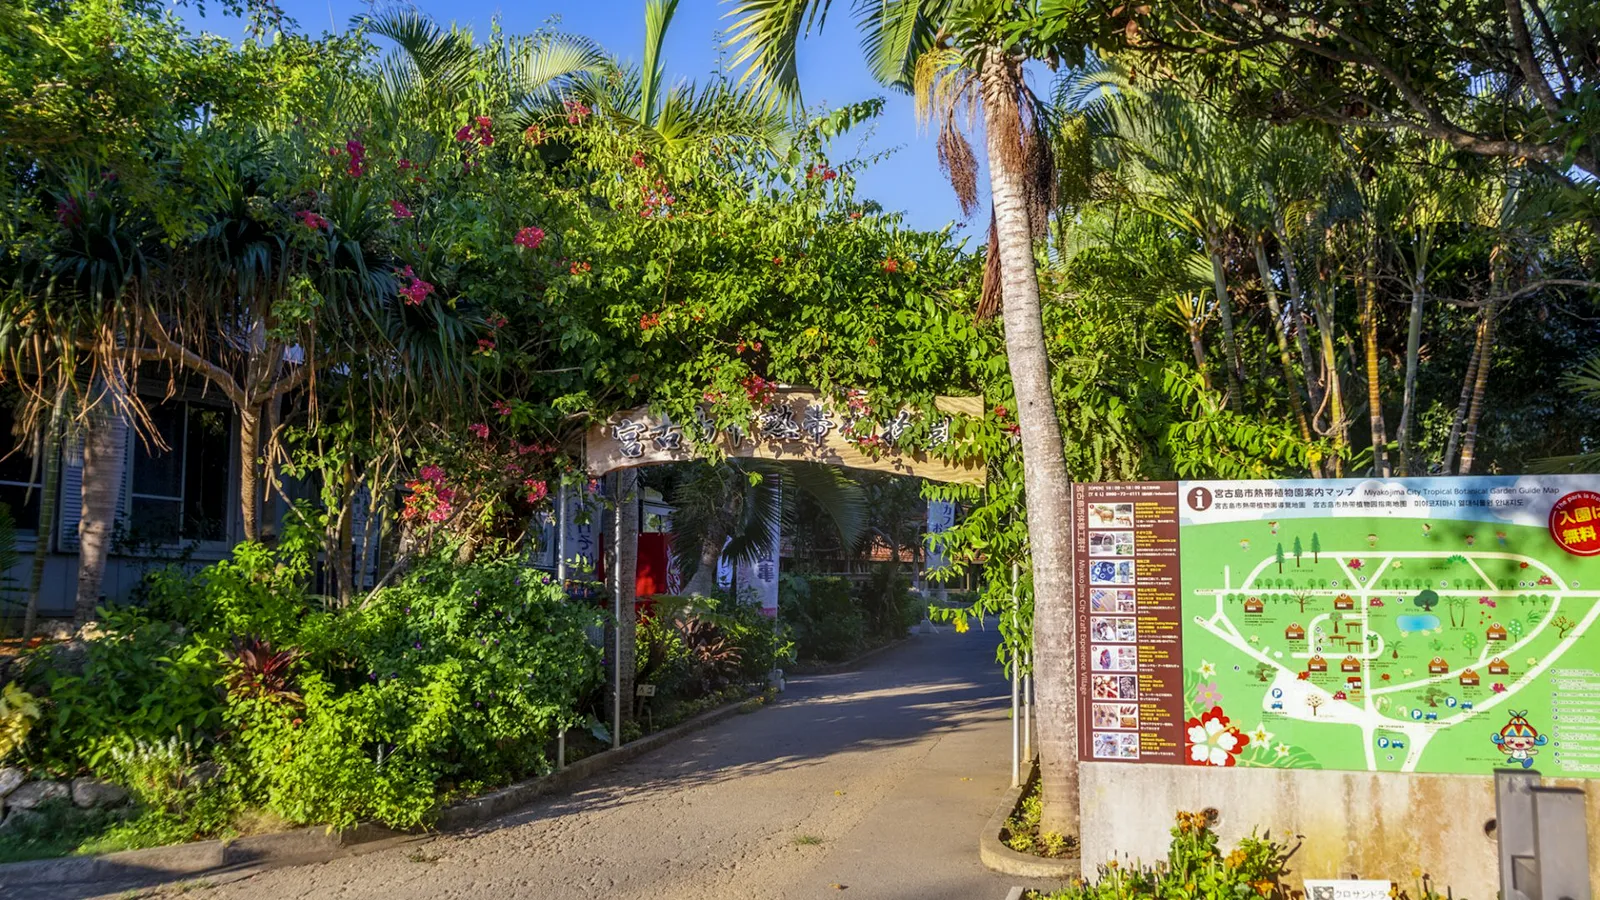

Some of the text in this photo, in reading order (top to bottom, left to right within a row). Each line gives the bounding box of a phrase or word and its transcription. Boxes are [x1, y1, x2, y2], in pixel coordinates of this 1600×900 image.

[1214, 487, 1356, 498] 宮古島市熱帯植物園案内マップ
[1364, 488, 1404, 497] Miyakojima
[1406, 488, 1421, 496] City
[1423, 488, 1452, 497] Tropical
[1542, 487, 1560, 495] Map
[1495, 499, 1524, 507] 안내지도
[1556, 500, 1567, 510] The
[1567, 493, 1582, 503] park
[1562, 525, 1597, 545] 無料
[1079, 634, 1088, 670] Experience
[1335, 890, 1386, 898] クロサンドラ
